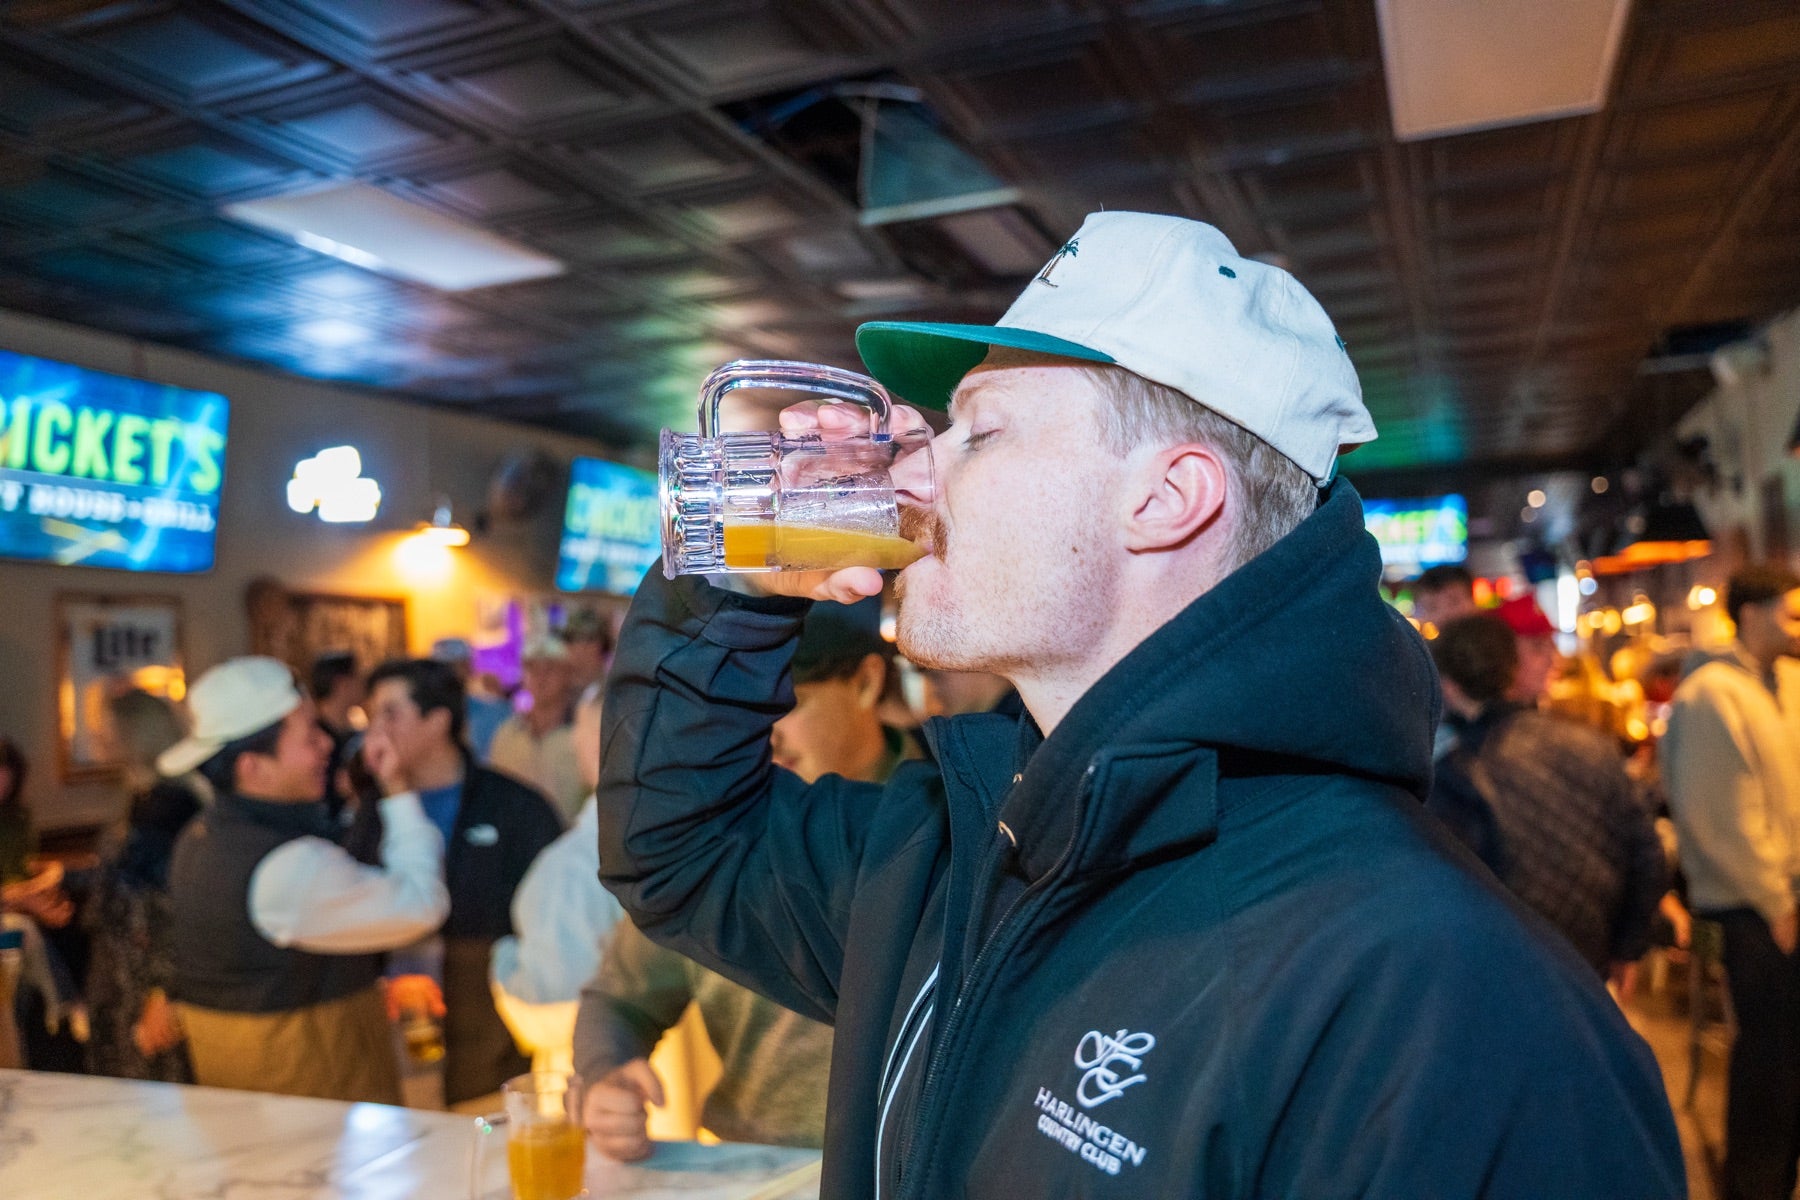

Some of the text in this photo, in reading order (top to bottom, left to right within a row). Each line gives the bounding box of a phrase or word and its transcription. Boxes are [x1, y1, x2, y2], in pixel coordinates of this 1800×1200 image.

[0, 395, 228, 495] ICKET'S
[1033, 1086, 1147, 1166] HARLINGEN
[1037, 1113, 1122, 1176] COUNTRY CLUB
